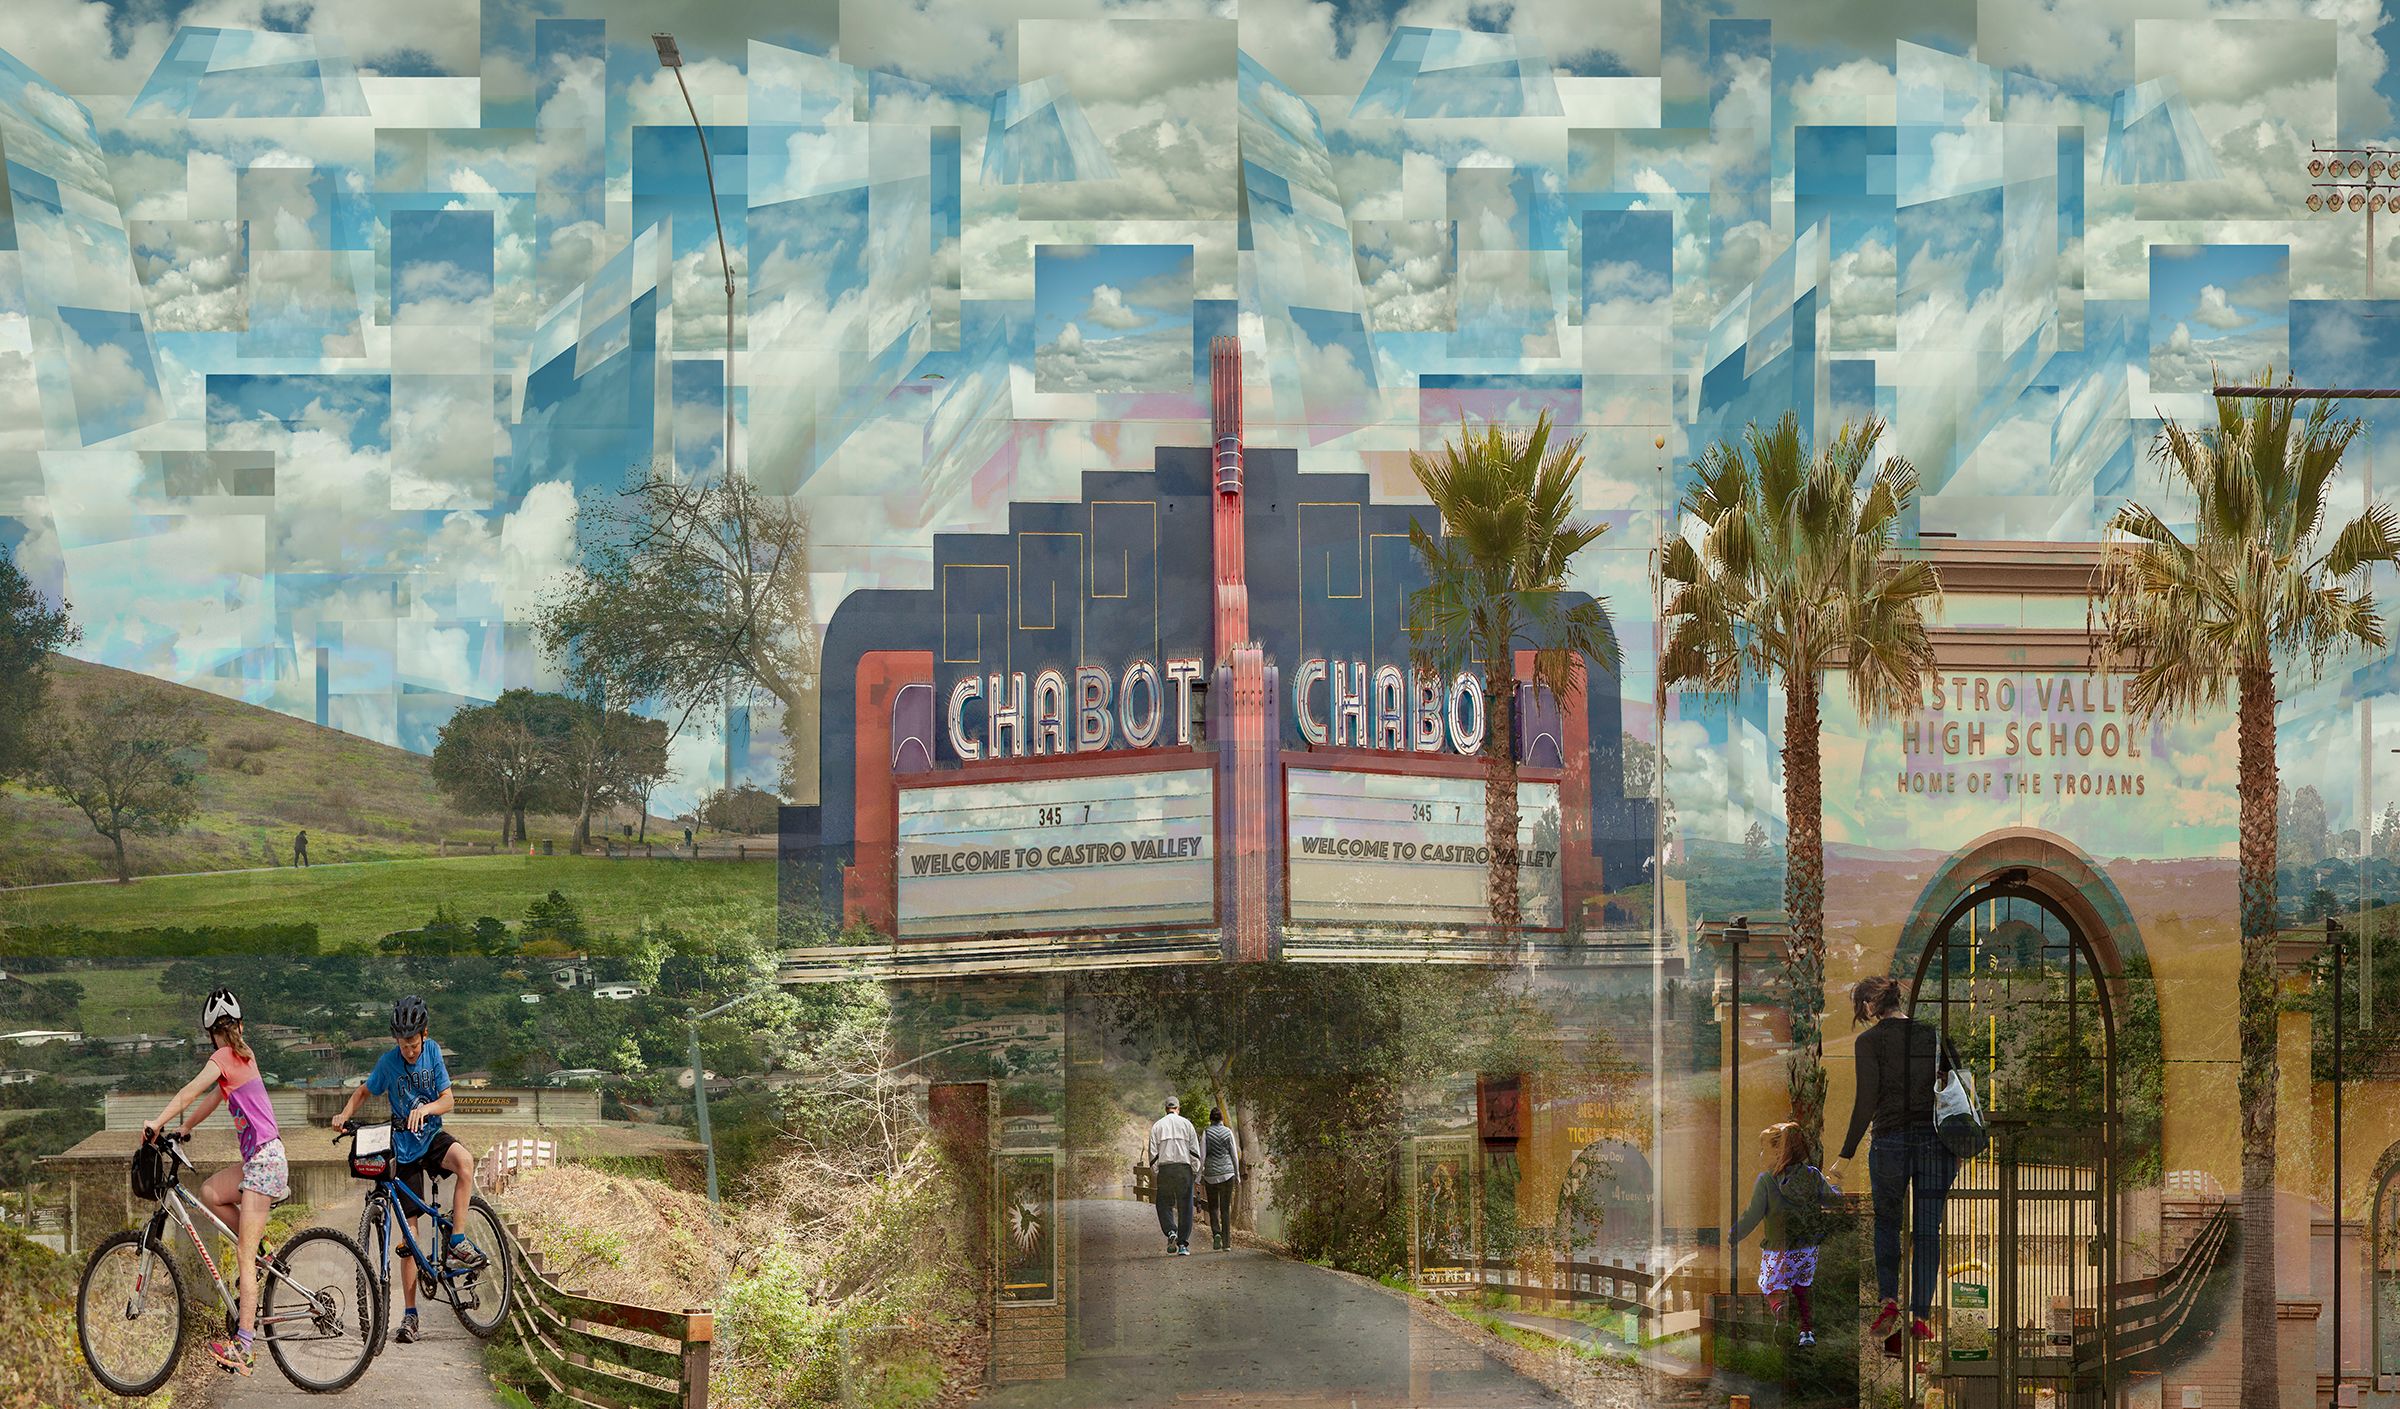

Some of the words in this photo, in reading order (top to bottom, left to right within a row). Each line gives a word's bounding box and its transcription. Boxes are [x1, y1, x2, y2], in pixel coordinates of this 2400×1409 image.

[948, 657, 1204, 761] CHABOT
[1292, 658, 1486, 757] CHABO
[1892, 677, 2016, 712] STRO
[2036, 678, 2138, 713] VALLE
[1903, 721, 1985, 755] HIGH
[2005, 722, 2140, 758] SCHOOL
[1898, 772, 1955, 793] HOME
[1967, 773, 1992, 793] OF
[2004, 773, 2041, 794] THE
[2053, 774, 2145, 796] TROJANS
[1038, 807, 1062, 826] 345
[1084, 805, 1090, 823] 7
[1411, 804, 1432, 822] 345
[1455, 806, 1461, 823] 7
[911, 849, 1010, 875] WELCOME
[1015, 847, 1042, 868] TO
[1047, 842, 1126, 866] CASTRO
[1131, 836, 1202, 860] VALLEY
[1302, 836, 1389, 858] WELCOME
[1393, 842, 1417, 860] TO
[1420, 844, 1490, 864] CASTRO
[1577, 1102, 1605, 1118] NEW
